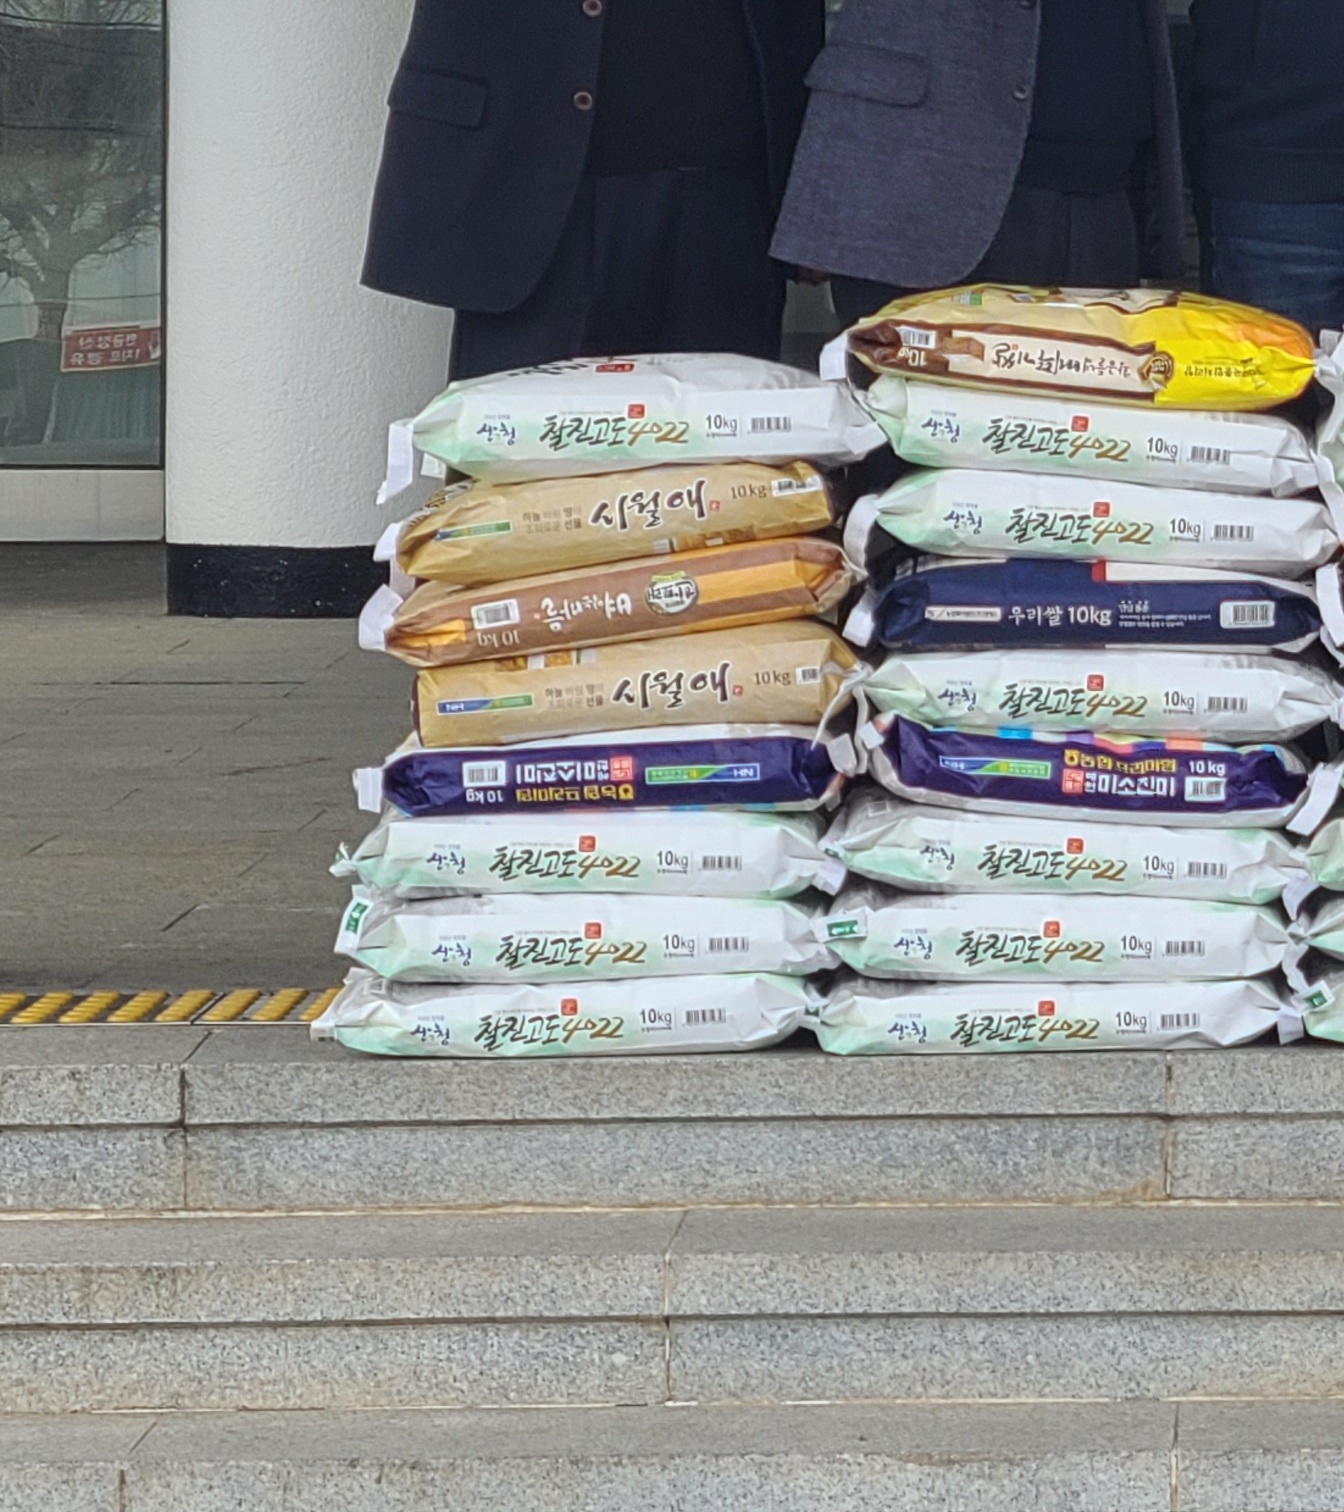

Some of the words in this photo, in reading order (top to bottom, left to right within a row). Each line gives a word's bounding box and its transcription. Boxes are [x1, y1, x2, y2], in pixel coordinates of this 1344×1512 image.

[706, 415, 737, 433] 10kg
[590, 479, 707, 531] 시월애
[1170, 519, 1201, 537] 10kg
[1009, 606, 1062, 627] 우리쌀
[1068, 607, 1111, 627] 10kg
[611, 661, 735, 709] 시월애
[516, 761, 597, 783] 미소진미
[1115, 759, 1176, 774] 프리미엄
[1099, 773, 1175, 796] 미소진미
[516, 787, 579, 802] 프리미엄
[1143, 857, 1174, 875] 10kg
[663, 934, 695, 953] 10kg
[1121, 936, 1152, 954] 10kg
[640, 1009, 671, 1027] 10kg
